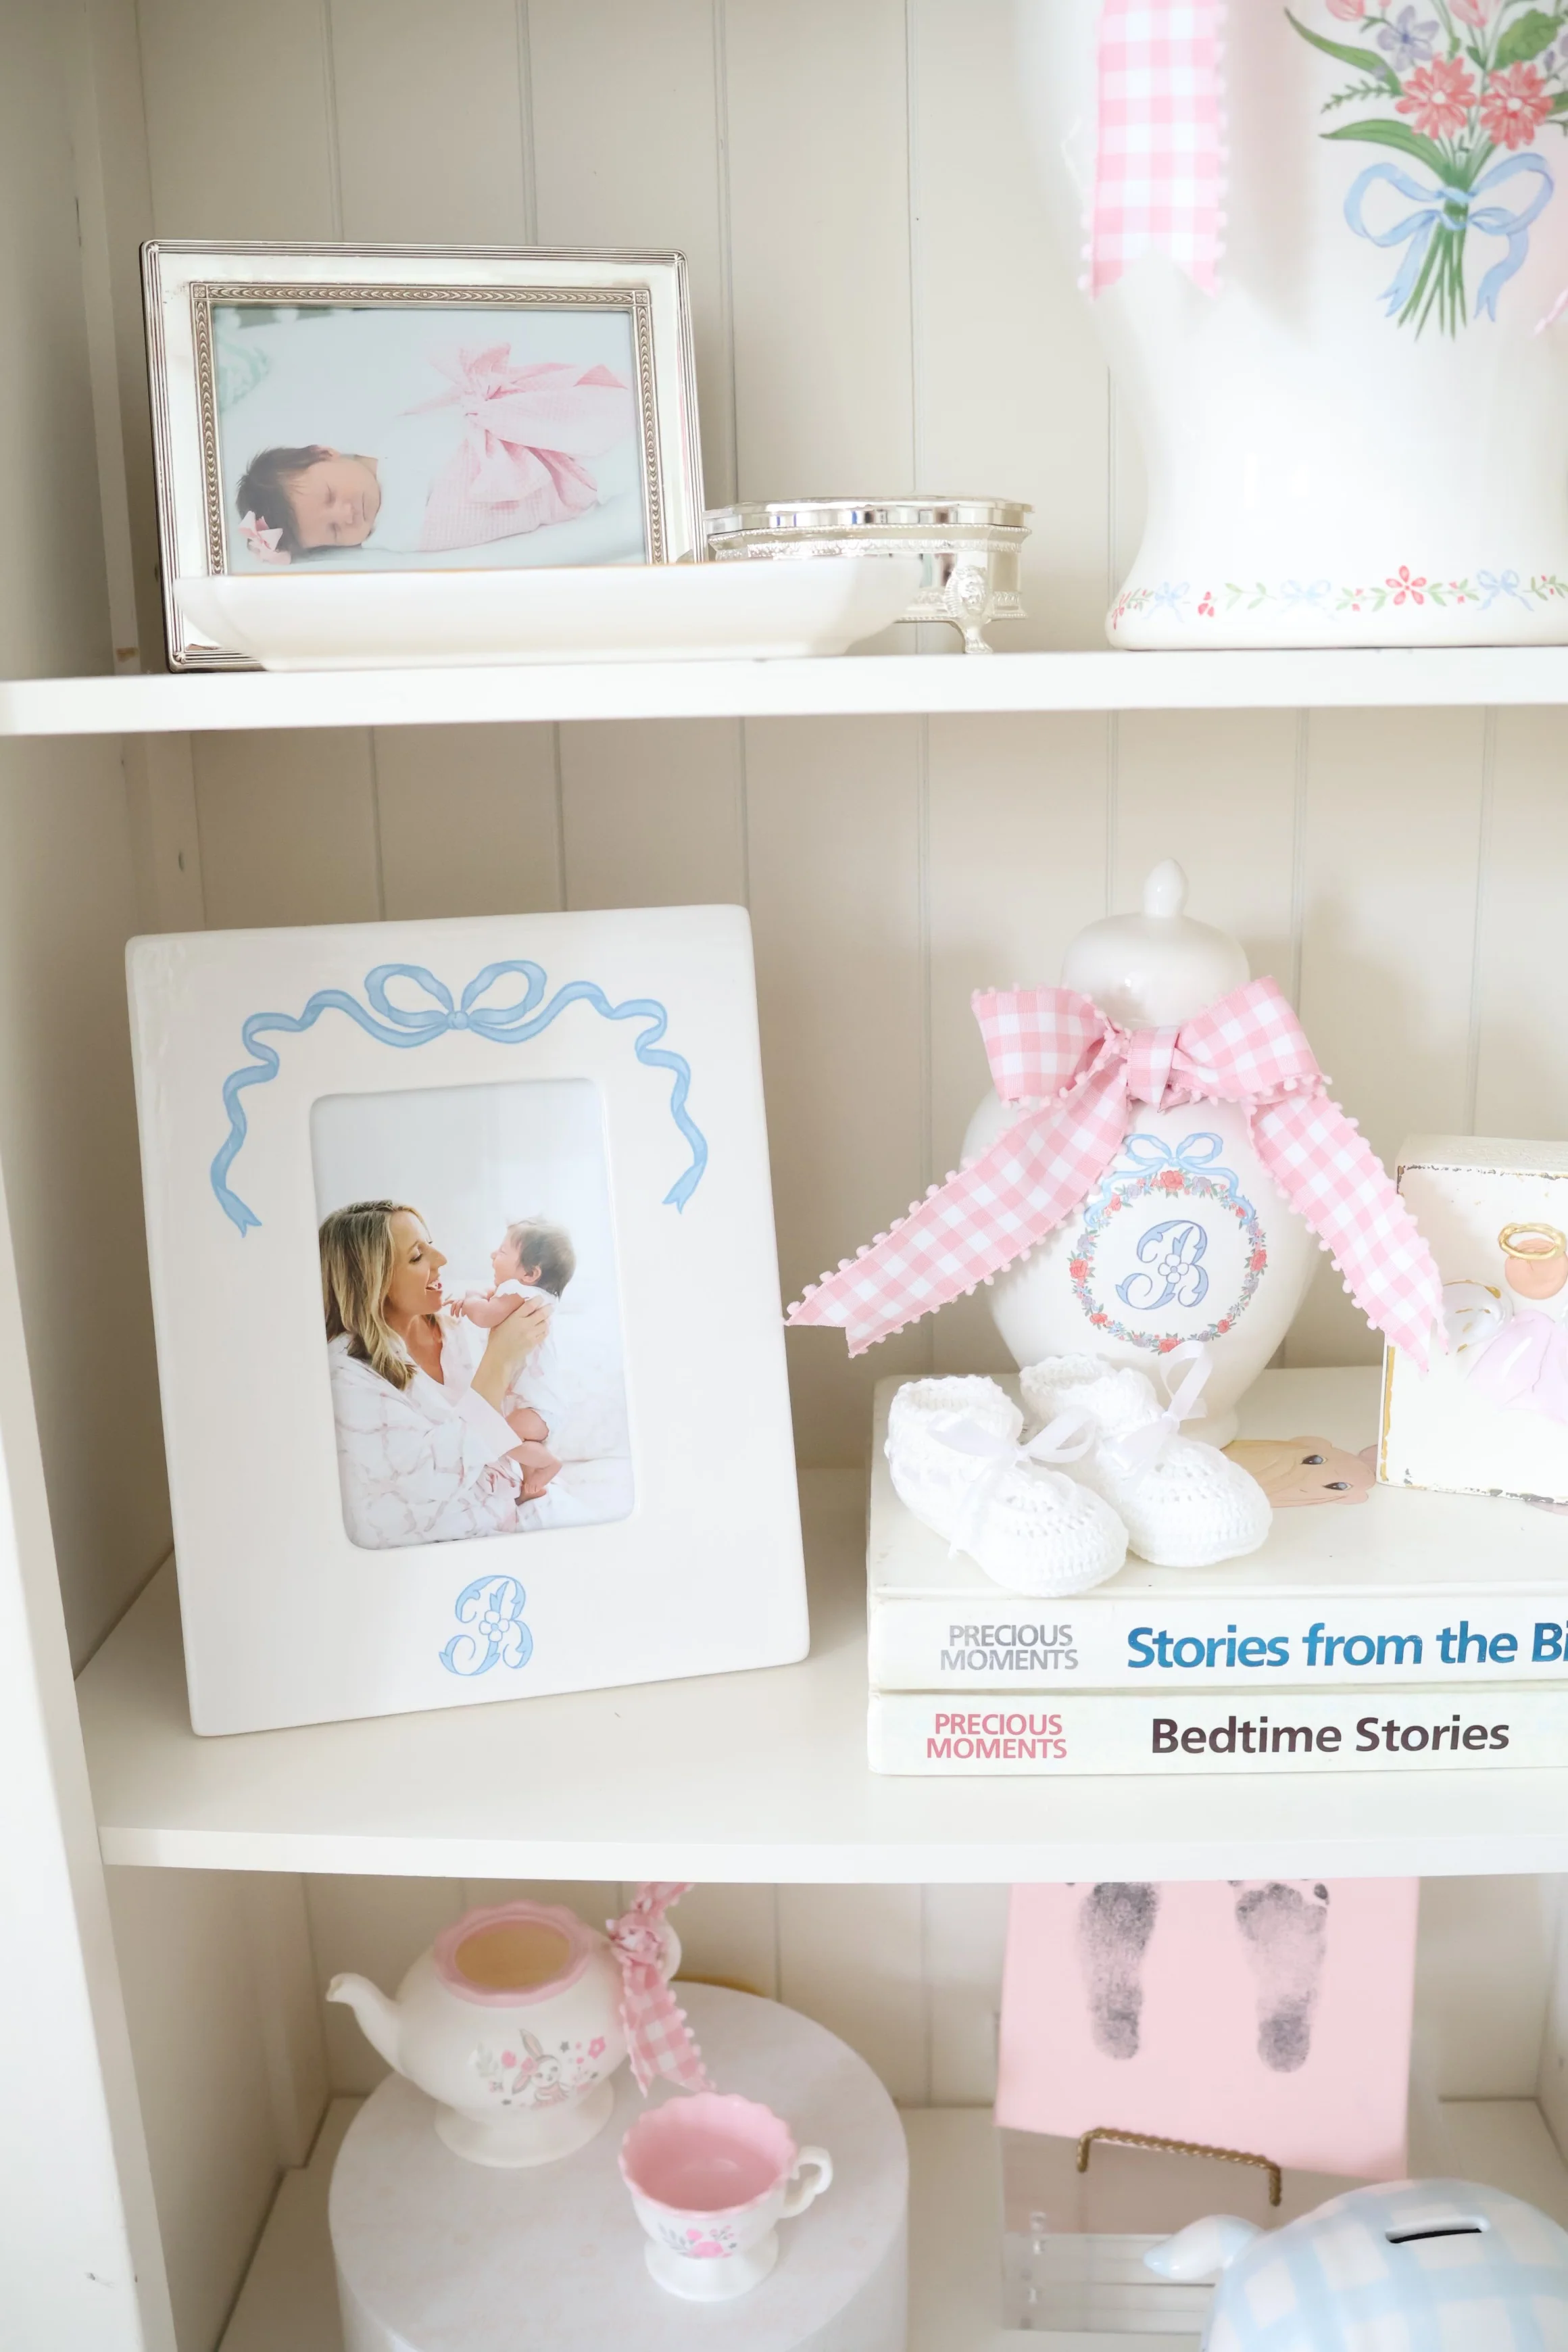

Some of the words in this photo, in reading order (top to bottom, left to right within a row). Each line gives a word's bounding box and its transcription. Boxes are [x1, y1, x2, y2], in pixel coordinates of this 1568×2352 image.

[948, 1624, 1073, 1648] PRECIOUS
[1127, 1623, 1290, 1669] Stories
[1302, 1622, 1423, 1667] from
[1435, 1620, 1519, 1665] the
[940, 1648, 1079, 1671] MOMENTS
[935, 1713, 1062, 1736] PRECIOUS
[1152, 1715, 1342, 1755] Bedtime
[1355, 1714, 1510, 1753] Stories
[927, 1737, 1068, 1759] MOMENTS
